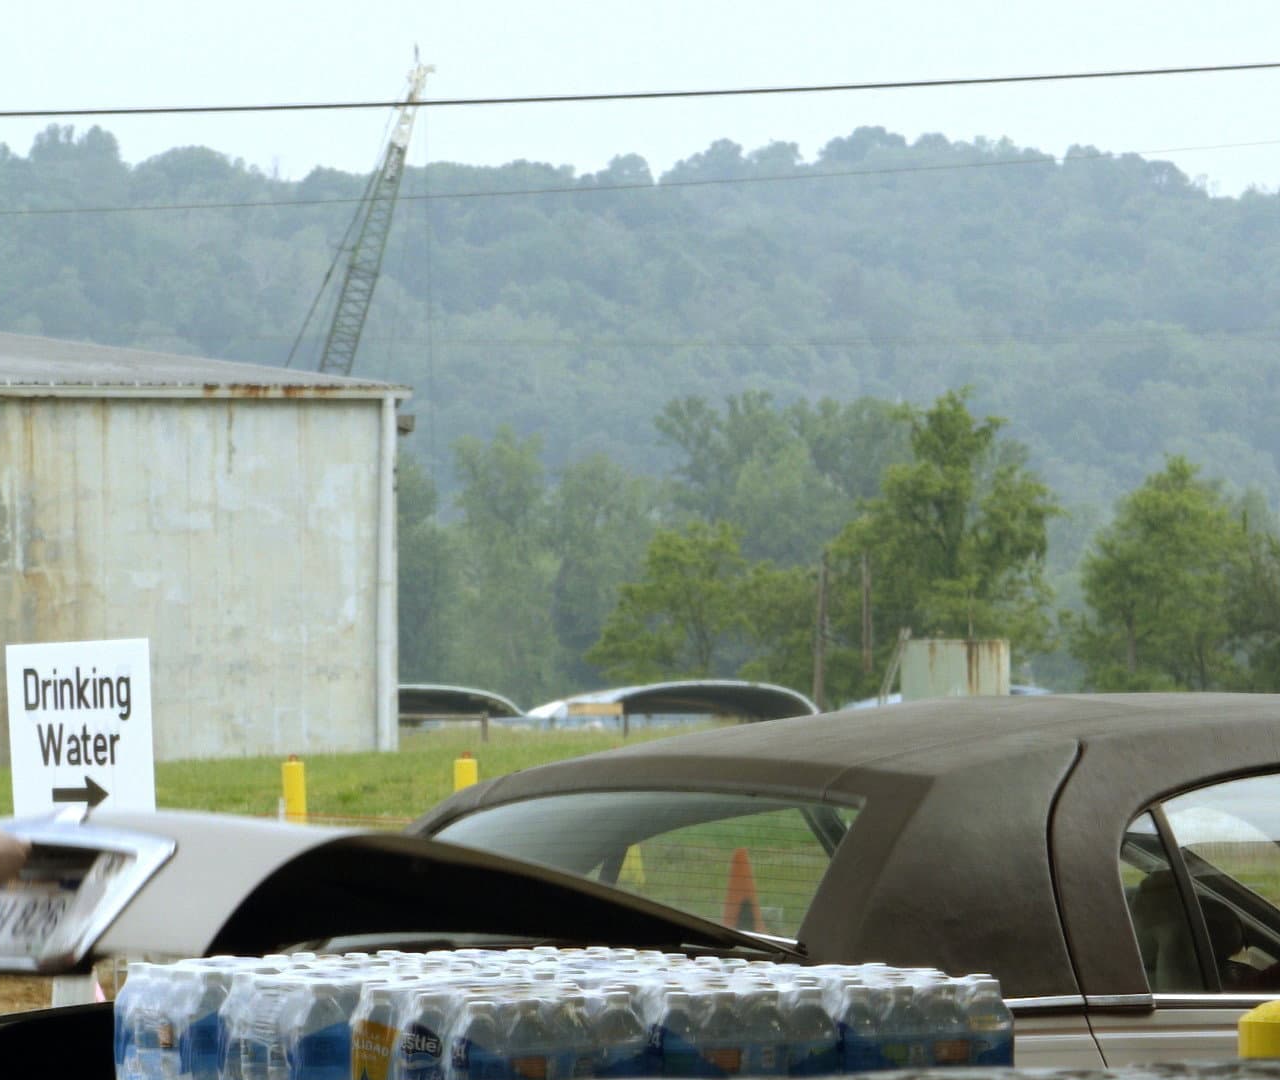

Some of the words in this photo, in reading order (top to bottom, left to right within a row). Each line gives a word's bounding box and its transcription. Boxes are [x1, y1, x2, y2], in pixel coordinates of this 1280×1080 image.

[23, 666, 131, 720] Drinking
[37, 723, 120, 766] Water
[402, 1032, 438, 1055] stlé
